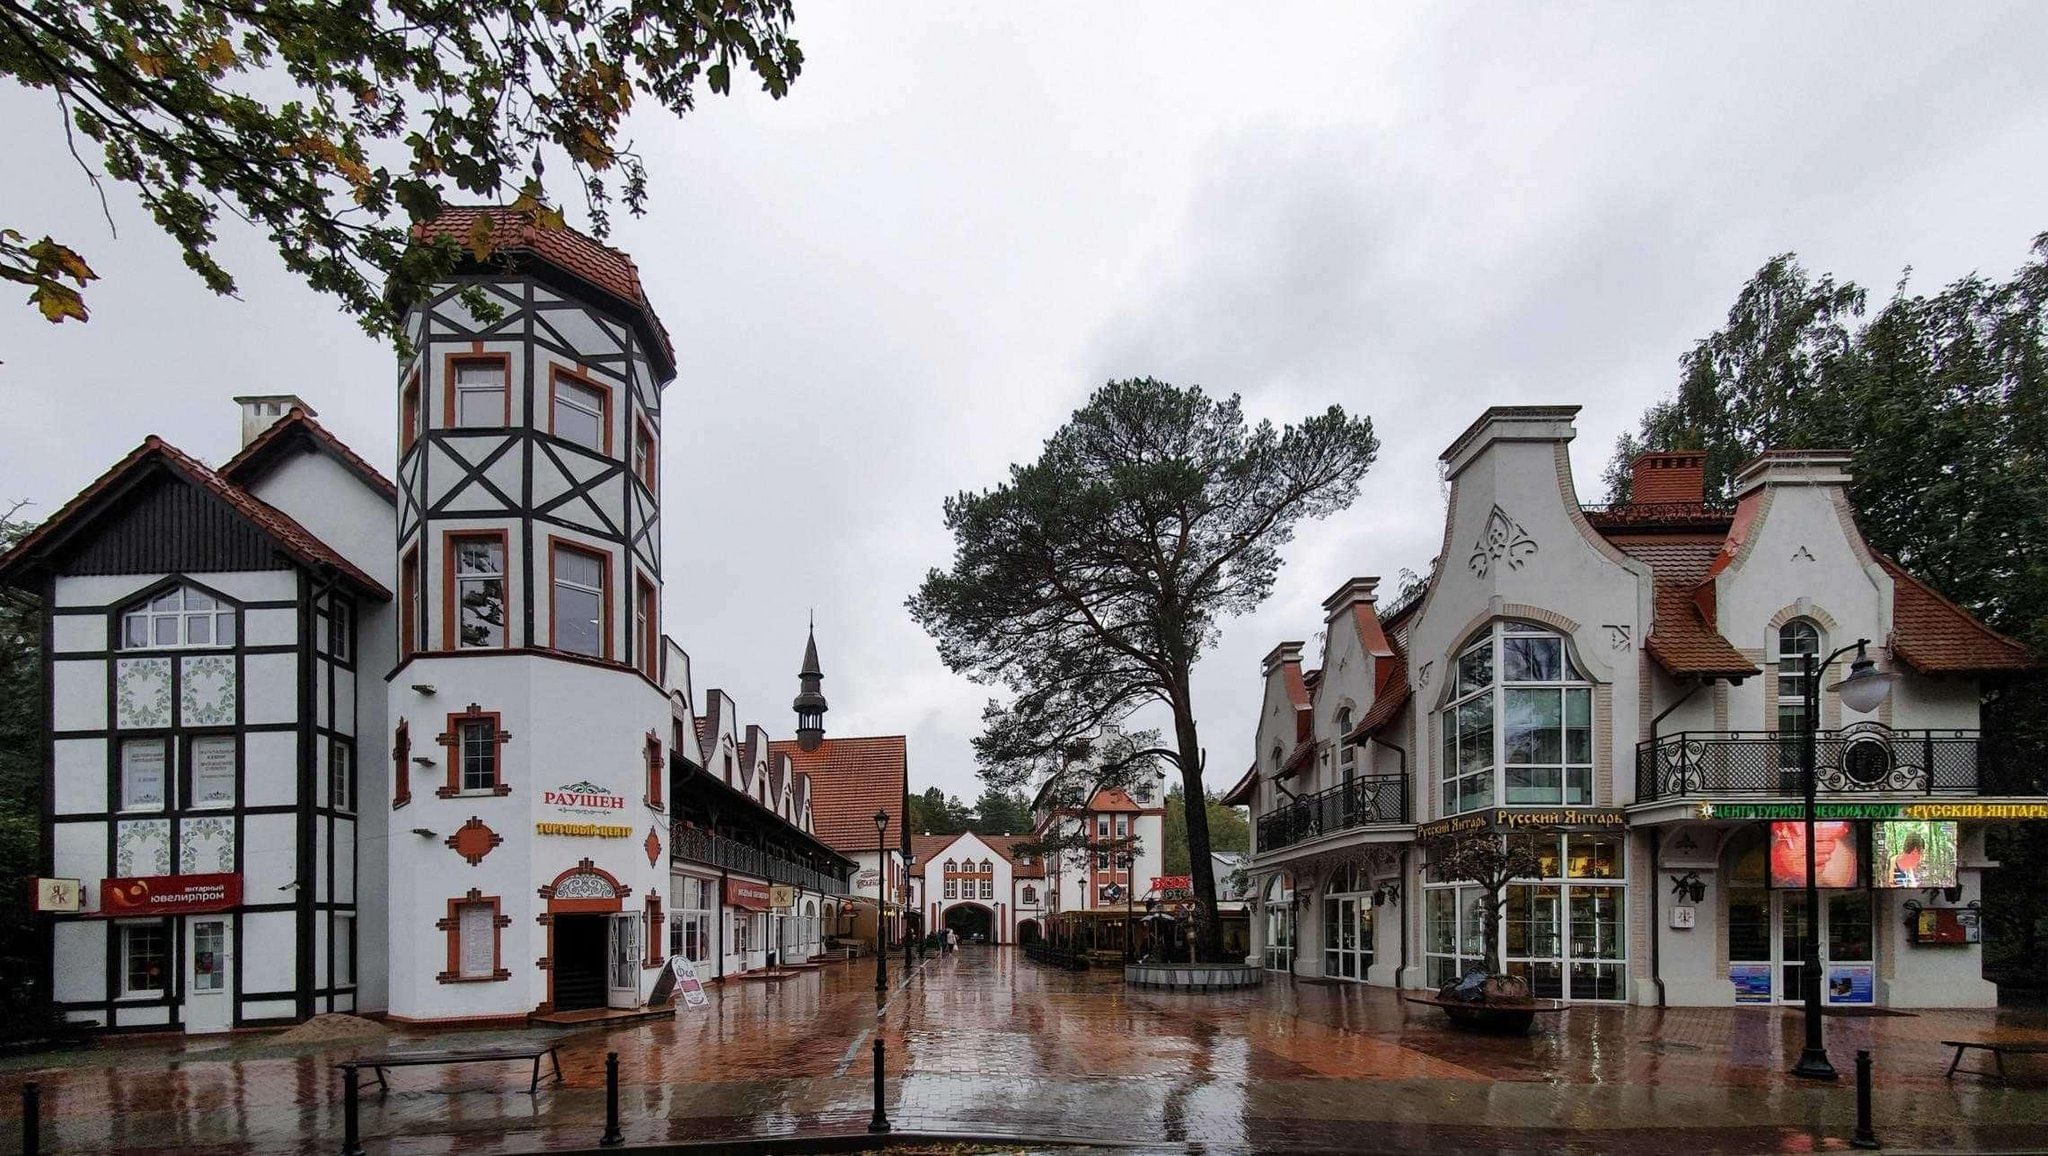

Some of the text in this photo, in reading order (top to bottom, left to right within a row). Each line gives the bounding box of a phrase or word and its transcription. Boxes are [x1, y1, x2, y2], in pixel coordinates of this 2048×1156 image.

[544, 792, 624, 808] РАУШЕН
[1497, 810, 1623, 828] Русский Янтарь
[1757, 804, 1863, 818] ТУРИСТЧЕСКИХ
[1914, 804, 2047, 818] РУССКИЙ ЯНТАРЬ
[536, 822, 632, 839] ТОРГОВЫЙ ЦЕНТР
[1417, 817, 1487, 838] Русский Янтарь
[150, 892, 225, 904] ювелирпром
